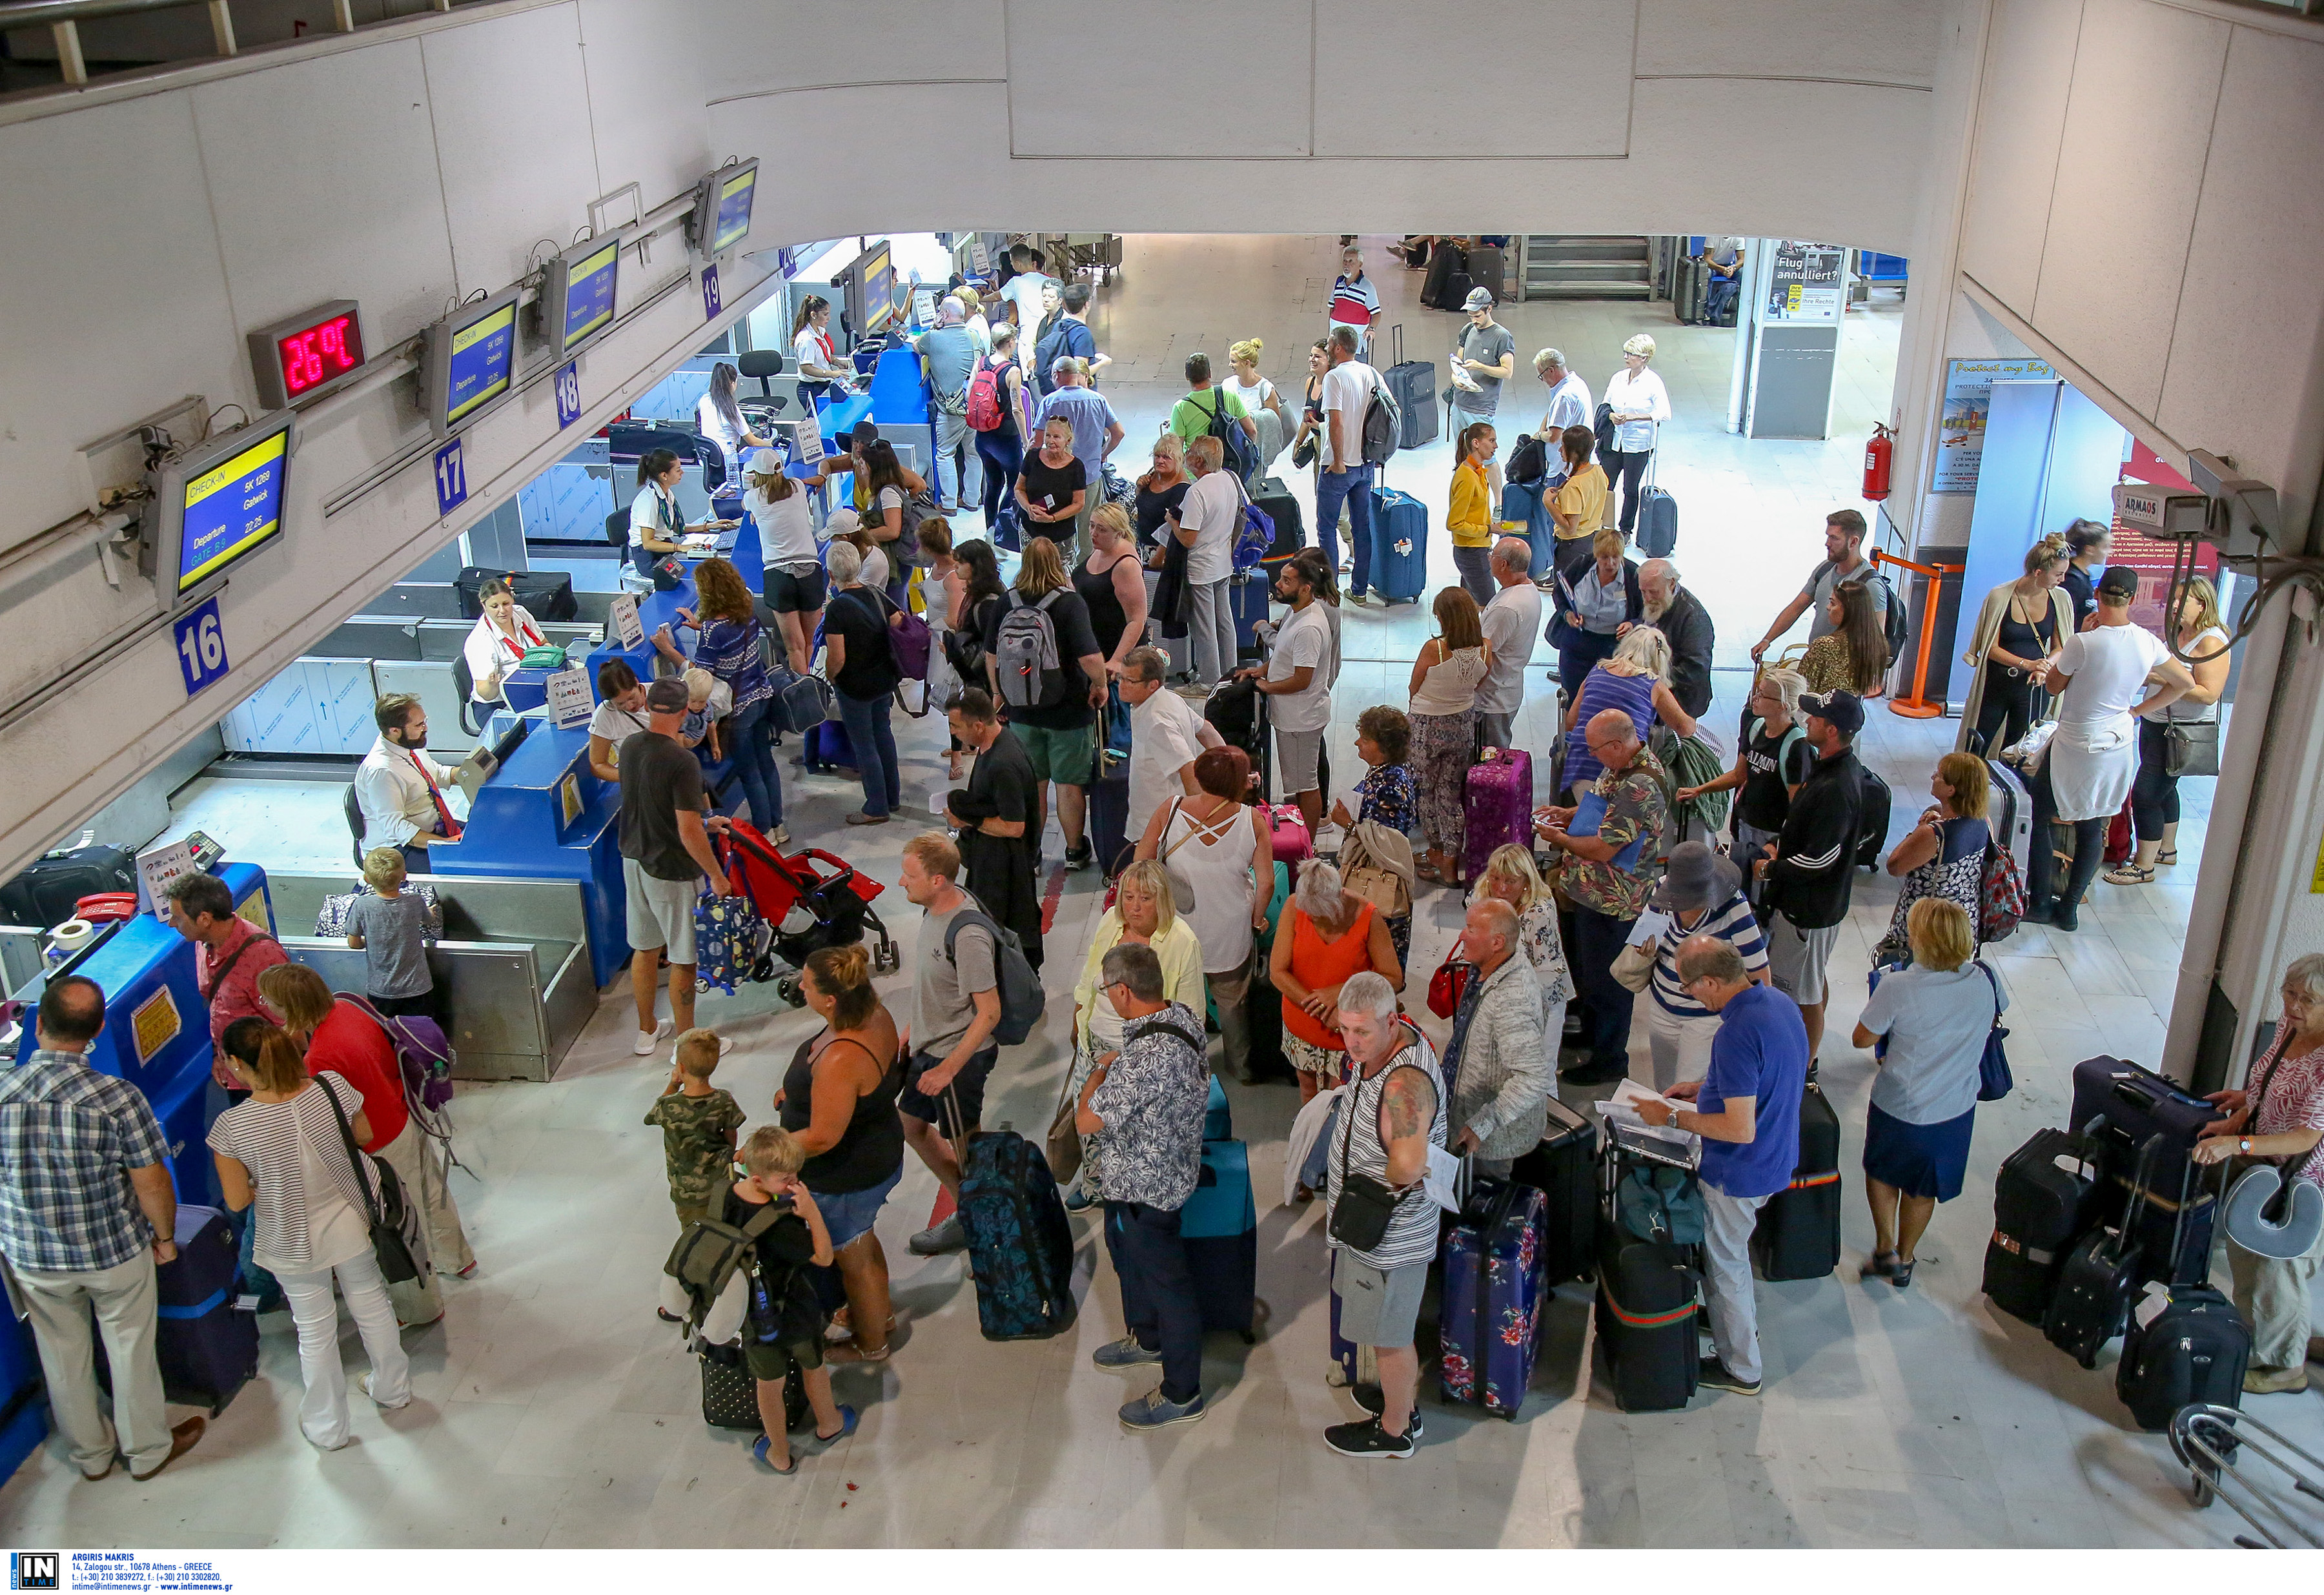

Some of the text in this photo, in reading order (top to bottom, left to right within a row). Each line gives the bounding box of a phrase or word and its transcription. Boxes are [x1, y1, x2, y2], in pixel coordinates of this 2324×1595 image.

[1779, 258, 1802, 270] Flug
[1777, 270, 1837, 280] annulliert?
[705, 277, 718, 307] 19
[1955, 362, 2050, 375] Protect my Bag
[456, 374, 476, 391] Departure
[559, 372, 578, 417] 18
[256, 470, 270, 486] 1269
[440, 447, 460, 501] 17
[190, 471, 226, 499] CHECK-IN
[243, 489, 268, 510] Gatwick
[2125, 498, 2156, 514] ARMAOS
[245, 515, 262, 534] 22:25
[194, 524, 226, 549] Departure
[191, 546, 212, 566] GATE
[181, 615, 222, 682] 16
